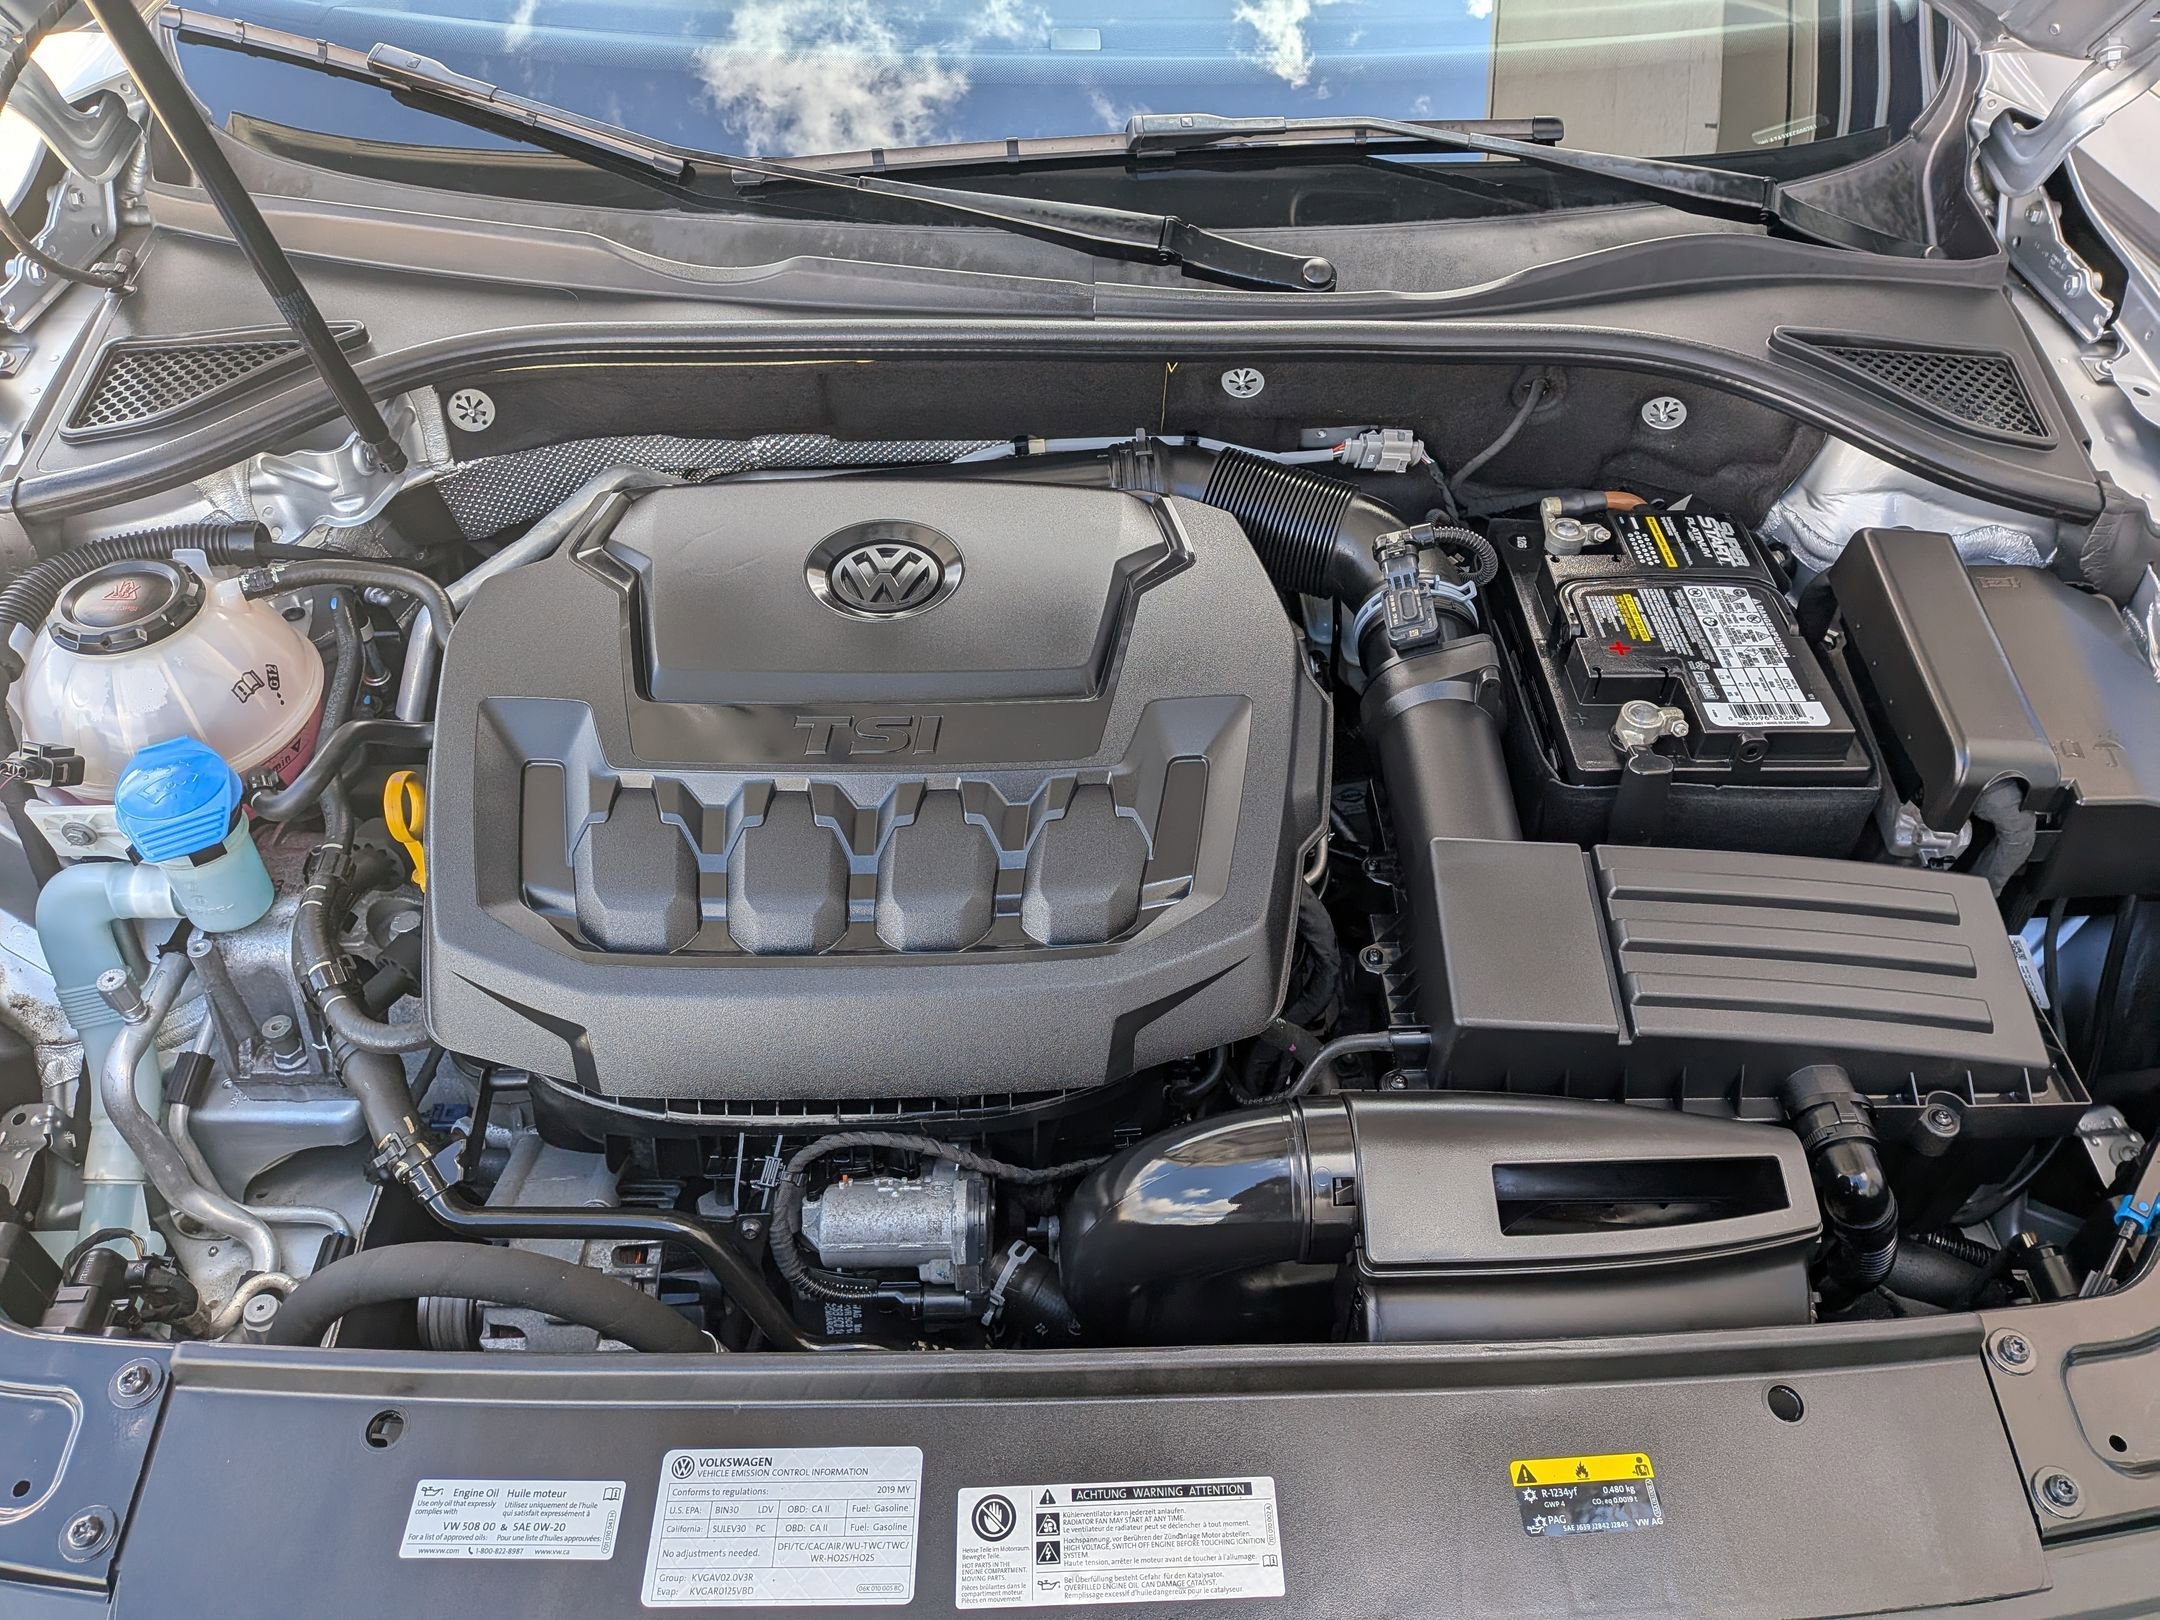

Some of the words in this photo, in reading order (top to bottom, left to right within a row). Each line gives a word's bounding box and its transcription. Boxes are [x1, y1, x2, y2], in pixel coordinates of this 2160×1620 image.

[1684, 516, 1713, 558] PLATINUM
[1697, 515, 1737, 568] START
[1719, 521, 1750, 567] SUPER
[267, 665, 279, 688] G12
[793, 715, 944, 756] TSI
[672, 1456, 695, 1479] VW
[699, 1457, 773, 1467] VOLKSWAGEN
[697, 1469, 730, 1477] VEHICLE
[731, 1469, 770, 1477] EMISSION
[772, 1468, 809, 1477] CONTROL
[811, 1467, 869, 1476] INFORMATION
[453, 1488, 484, 1499] Engine
[486, 1488, 500, 1498] Oil
[507, 1489, 531, 1498] Huile
[533, 1490, 567, 1498] moteur
[672, 1487, 710, 1496] Conforms
[712, 1488, 720, 1496] to
[722, 1487, 769, 1498] regulations:
[877, 1485, 896, 1494] 2019
[897, 1485, 911, 1494] MY
[1076, 1488, 1127, 1500] ACHTUNG
[1133, 1486, 1183, 1498] WARNING
[1189, 1484, 1245, 1496] ATTENTION
[1541, 1486, 1577, 1499] R-1234yf
[1602, 1485, 1624, 1494] 0.480
[1625, 1485, 1636, 1495] kg
[430, 1500, 443, 1508] only
[467, 1500, 497, 1508] expressly
[529, 1502, 568, 1510] uniquement
[669, 1506, 684, 1514] U.S.
[685, 1506, 702, 1514] EPA:
[715, 1505, 740, 1514] BIN30
[757, 1505, 775, 1514] LDV
[787, 1505, 808, 1513] OBD:
[811, 1505, 825, 1513] CA
[852, 1504, 871, 1513] Fuel:
[874, 1503, 909, 1512] Gasoline
[415, 1508, 442, 1516] complies
[502, 1510, 513, 1518] qui
[540, 1510, 585, 1518] expressément
[1063, 1510, 1112, 1518] Kühlerventilator
[1129, 1508, 1156, 1517] jederzeit
[1157, 1507, 1186, 1515] anlaufen.
[1124, 1516, 1143, 1524] START
[1547, 1514, 1567, 1525] PAG
[1635, 1518, 1650, 1526] VW
[1651, 1517, 1664, 1525] AG
[443, 1522, 460, 1531] VW
[462, 1522, 480, 1531] 508
[483, 1522, 496, 1531] 00
[500, 1523, 508, 1531] &
[512, 1522, 531, 1531] SAE
[533, 1522, 567, 1532] 0W-20
[666, 1525, 703, 1533] California:
[712, 1524, 747, 1533] SULEV30
[755, 1524, 766, 1532] PC
[785, 1524, 806, 1532] OBD:
[809, 1524, 823, 1532] CA
[850, 1523, 869, 1532] Fuel:
[873, 1523, 908, 1531] Gasoline
[1562, 1524, 1576, 1532] SAE
[442, 1533, 473, 1542] approved
[563, 1535, 602, 1543] approuvées:
[777, 1541, 910, 1551] DFI/TC/CAC/AIR/WU-TWC/TWC/
[1081, 1543, 1111, 1551] VOLTAGE,
[1236, 1537, 1266, 1545] IGNITION
[475, 1547, 524, 1555] 1-800-822-8987
[662, 1549, 675, 1557] No
[676, 1549, 726, 1559] adjustments
[728, 1548, 760, 1557] needed.
[810, 1553, 875, 1562] WR-HO2S/HO2S
[659, 1573, 687, 1583] Group:
[691, 1573, 754, 1582] KVGAV02.0V3R
[1163, 1572, 1173, 1580] für
[1064, 1583, 1101, 1591] OVERFILLED
[1102, 1582, 1127, 1590] ENGINE
[656, 1587, 679, 1597] Evap:
